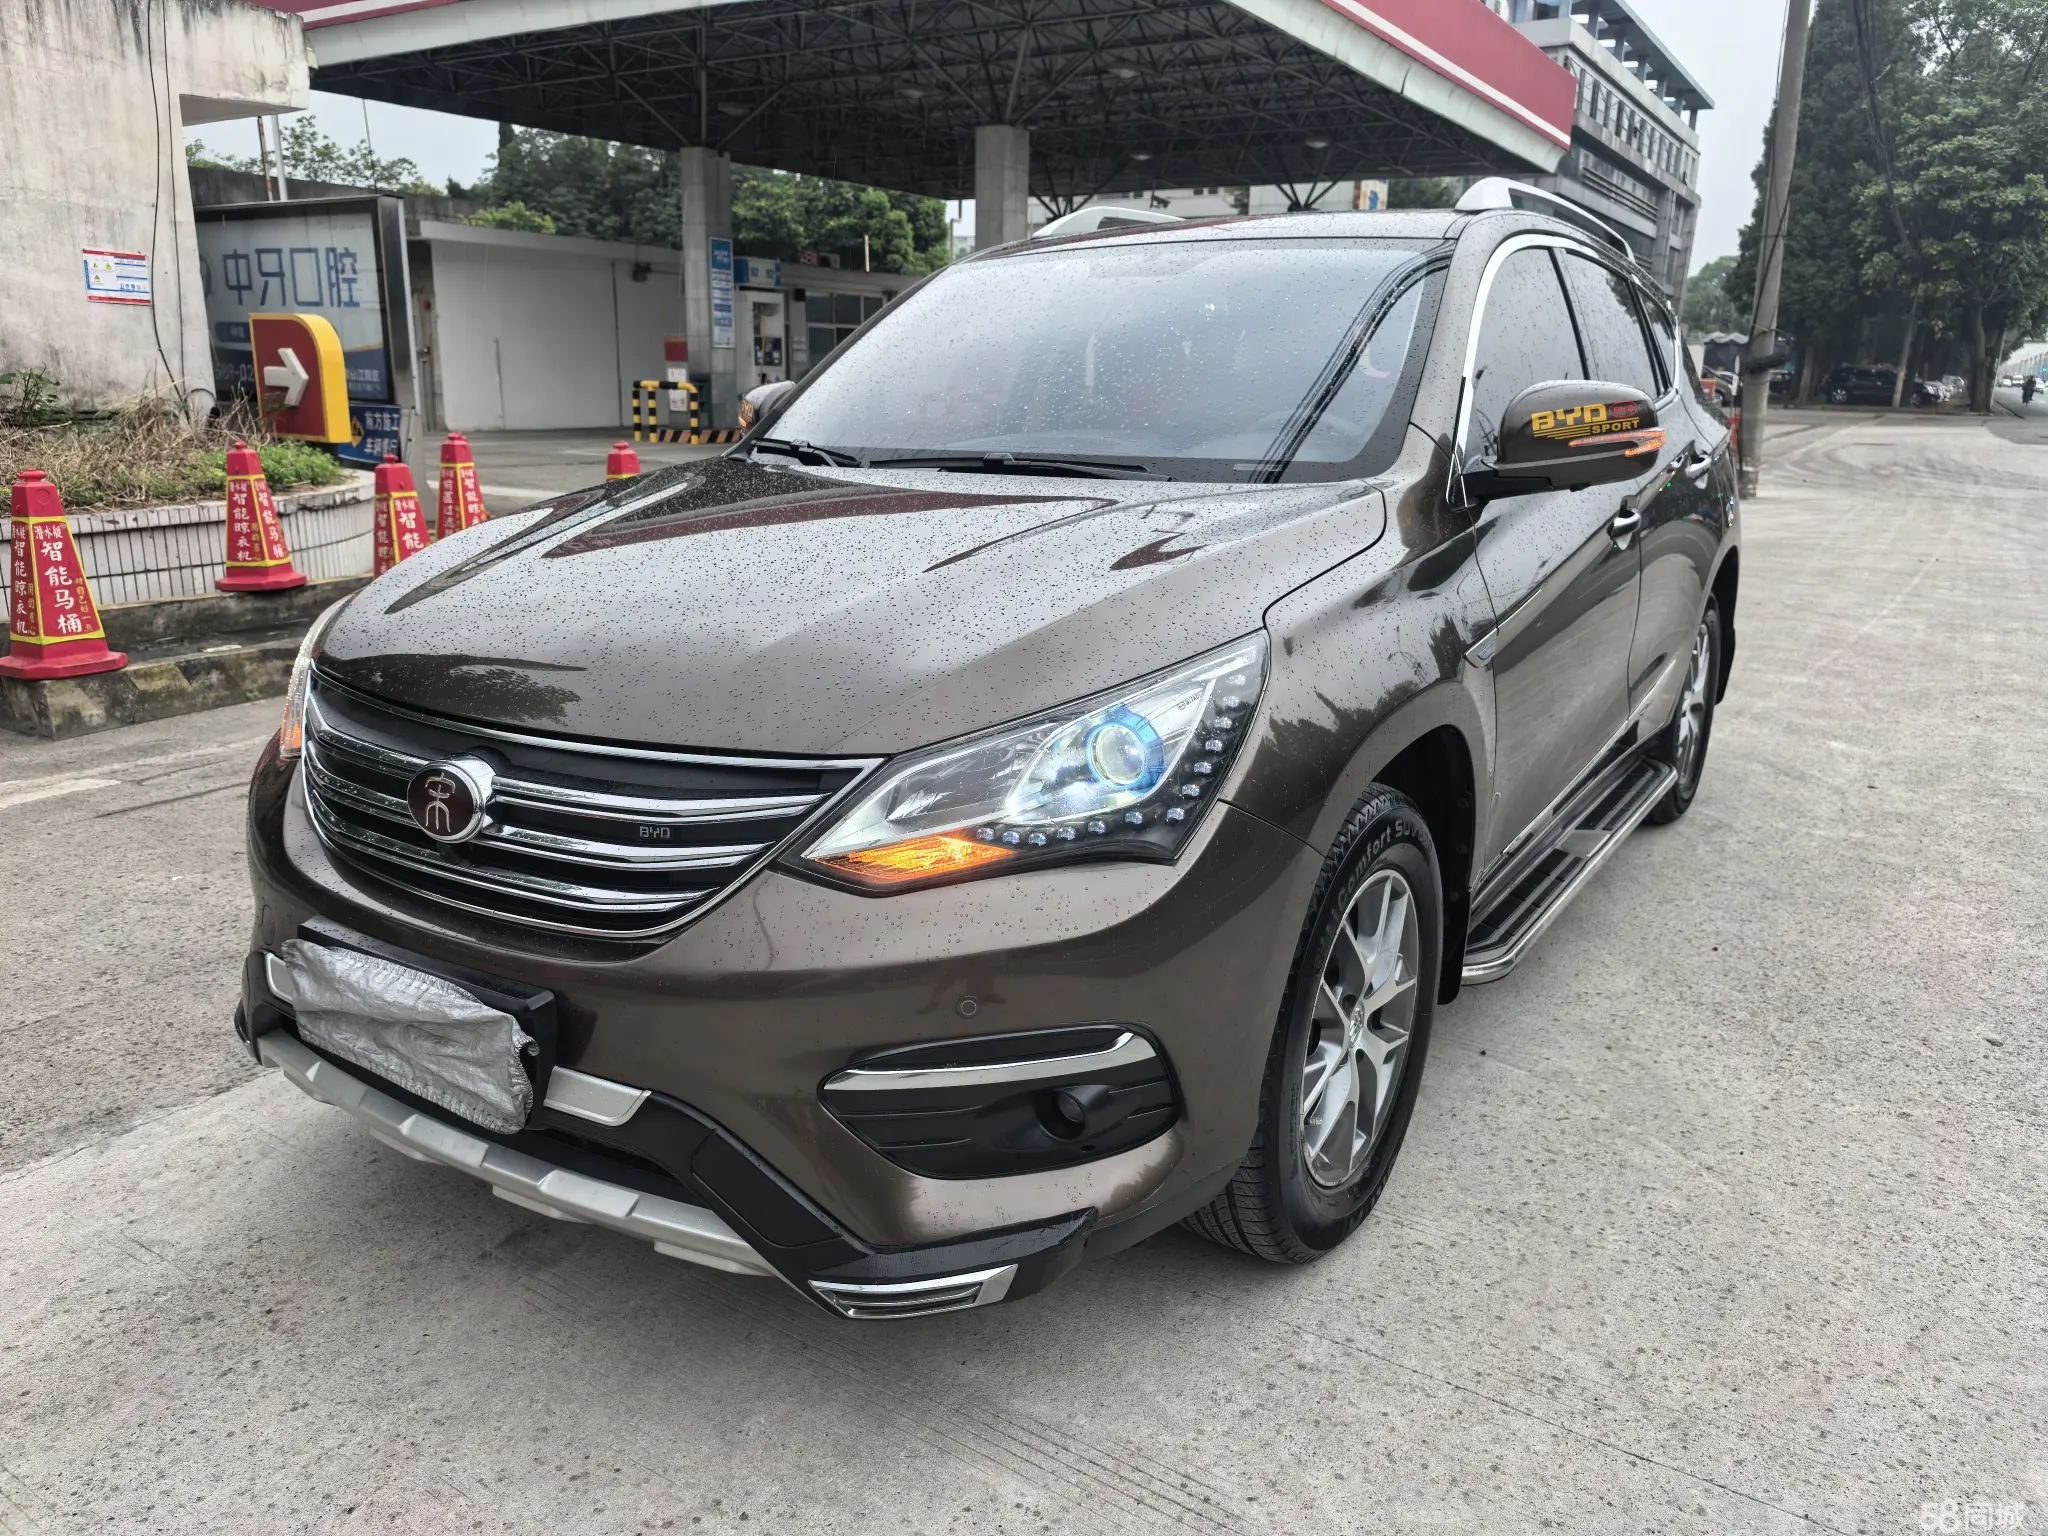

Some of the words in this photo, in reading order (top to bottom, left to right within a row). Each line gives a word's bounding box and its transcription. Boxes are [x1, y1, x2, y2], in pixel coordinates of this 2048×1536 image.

[223, 247, 360, 308] 中牙口腔
[1531, 404, 1607, 431] BYD
[1591, 420, 1640, 434] SPORT
[34, 525, 63, 539] 潜水艇
[233, 493, 252, 561] 智能晾衣机
[259, 492, 284, 558] 智能马桶
[14, 541, 28, 634] 智能晾衣机
[41, 541, 82, 633] 智能马桶
[640, 825, 671, 839] BYD
